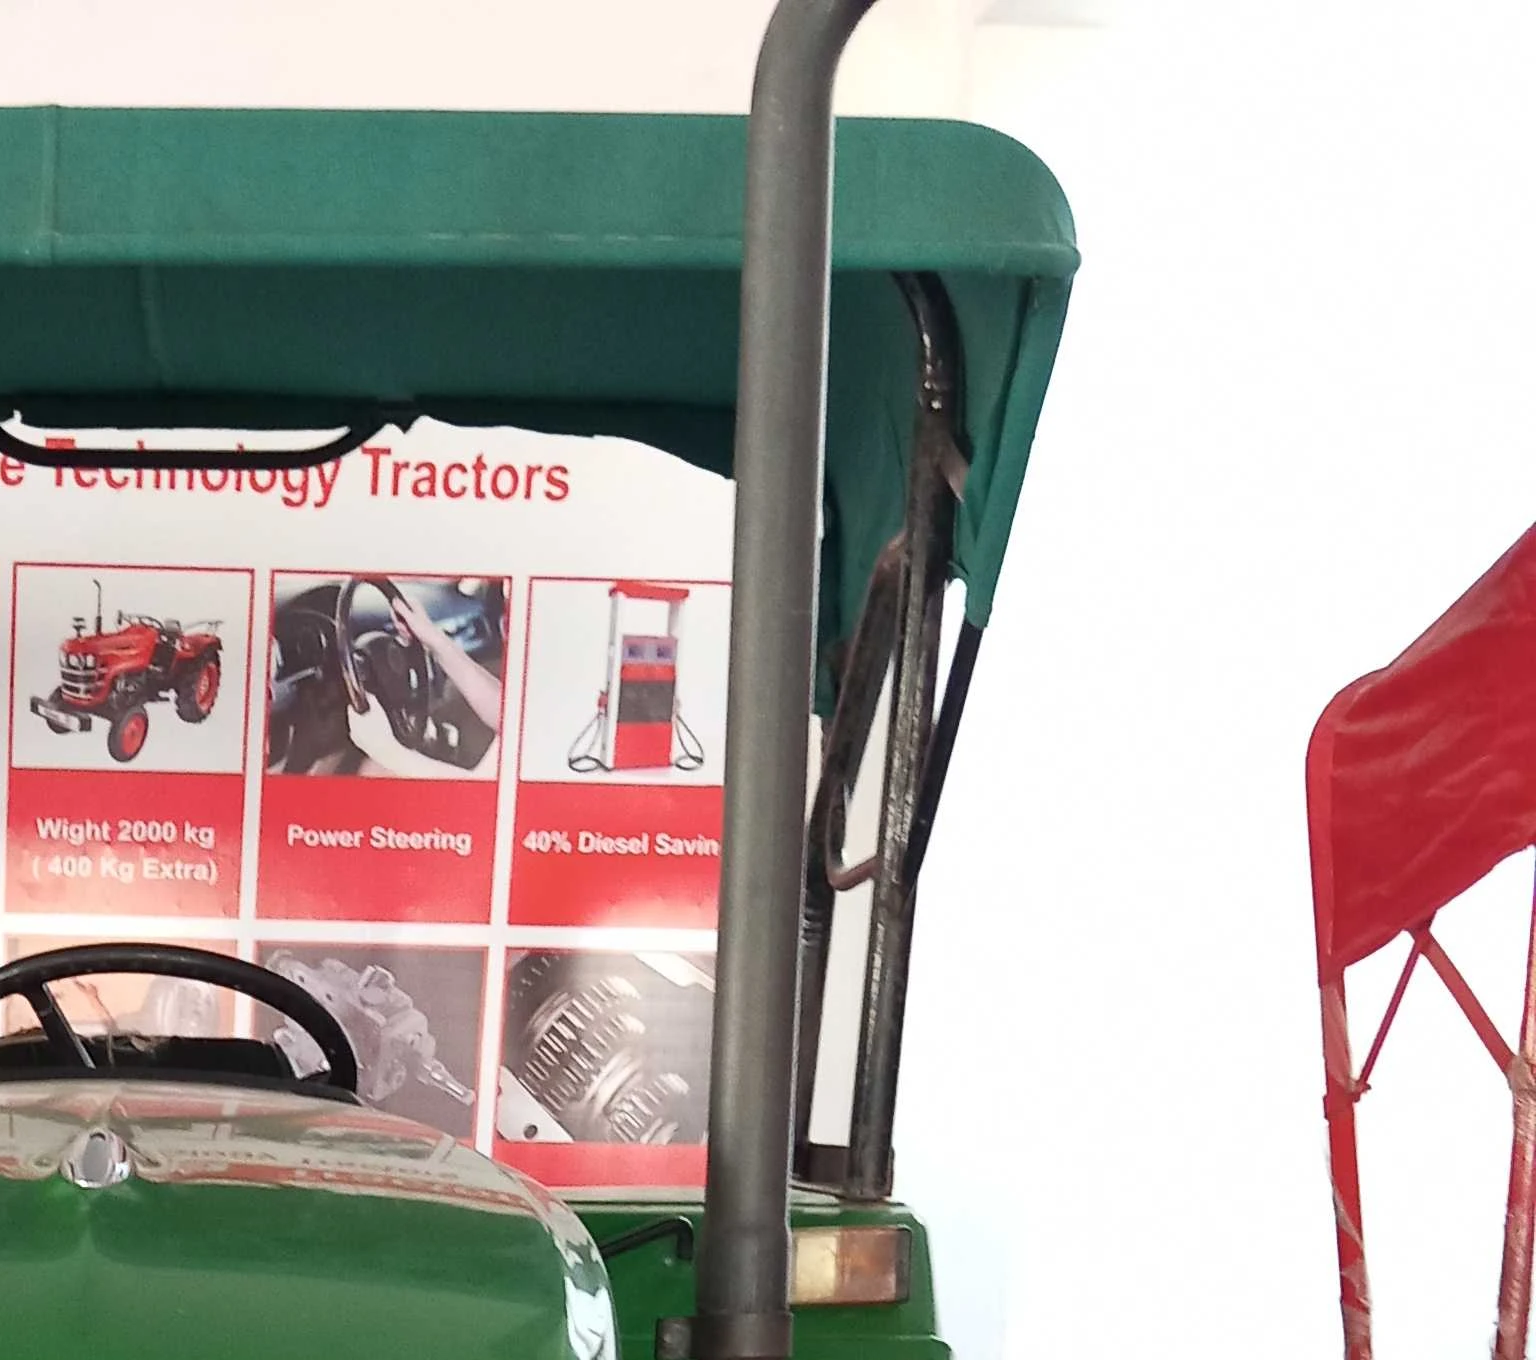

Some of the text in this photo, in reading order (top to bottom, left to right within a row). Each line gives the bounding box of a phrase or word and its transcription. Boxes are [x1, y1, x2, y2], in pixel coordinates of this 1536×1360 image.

[45, 437, 342, 508] Technology
[361, 443, 569, 501] Tractors
[36, 817, 215, 849] Wight 2000 kg
[287, 824, 472, 857] Power Steering
[522, 829, 721, 857] 40% Diesel Savin
[100, 856, 134, 884] Kg
[142, 857, 218, 886] Extra)
